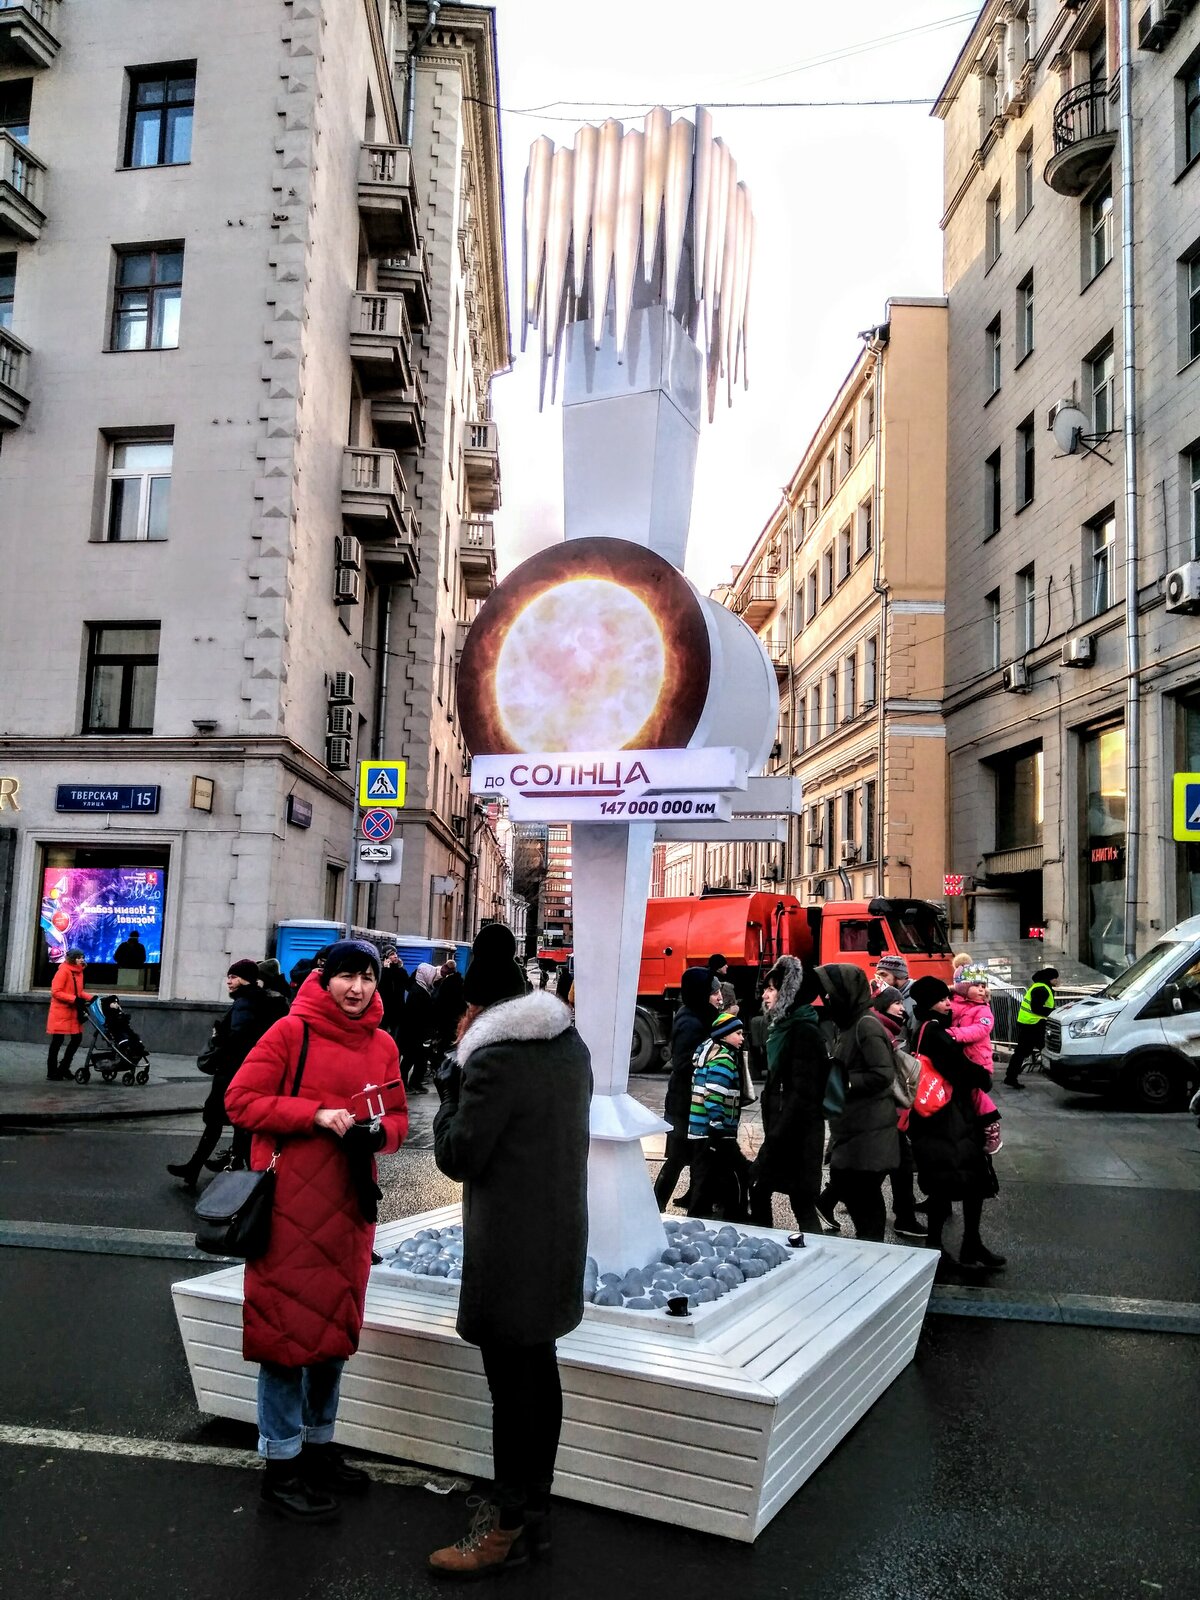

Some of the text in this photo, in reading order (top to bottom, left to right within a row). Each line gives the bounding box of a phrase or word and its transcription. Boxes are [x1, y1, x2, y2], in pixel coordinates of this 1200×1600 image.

[509, 761, 651, 788] СОЛНЦА
[70, 790, 151, 806] ТВЕРСКАЯ 15
[600, 801, 626, 815] 147
[628, 801, 659, 815] 000
[661, 800, 693, 814] 000
